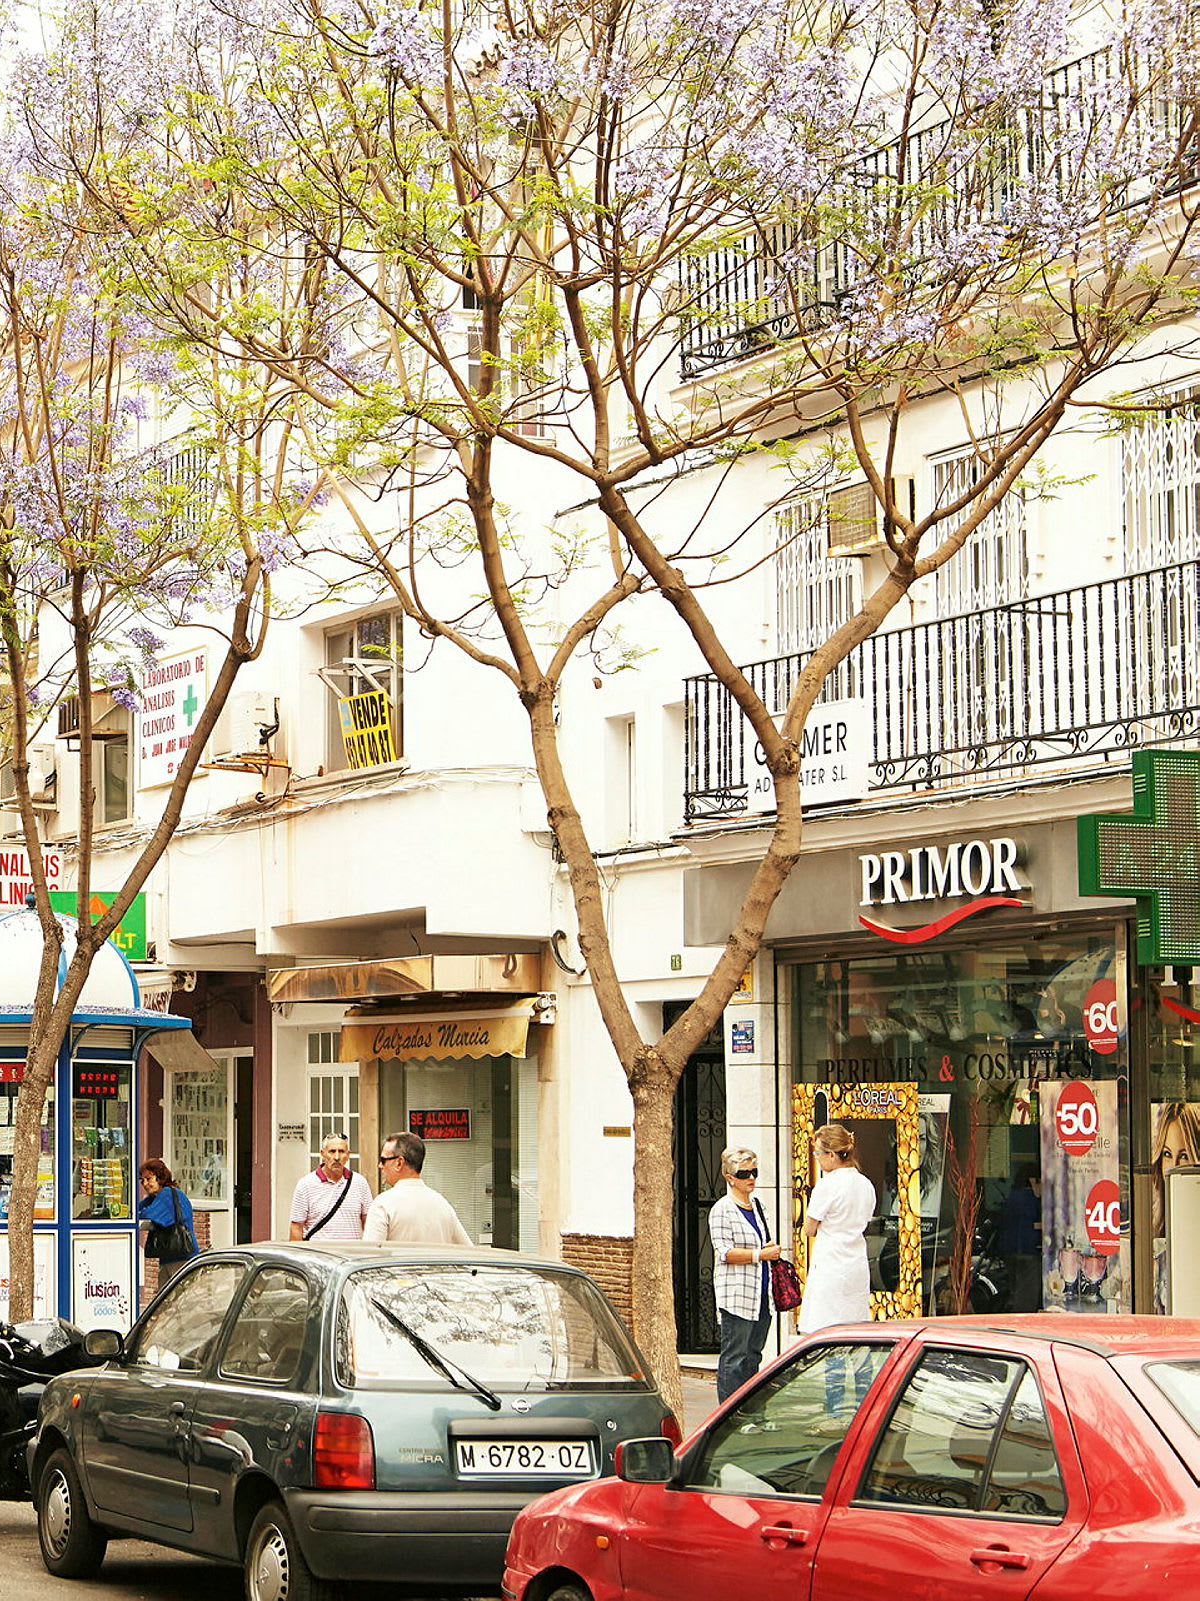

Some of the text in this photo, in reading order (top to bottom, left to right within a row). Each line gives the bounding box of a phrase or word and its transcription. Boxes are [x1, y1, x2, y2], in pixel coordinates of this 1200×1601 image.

[142, 655, 205, 689] LABORATORIO DE
[143, 690, 175, 713] ANALISIS
[349, 693, 387, 731] VENDE
[142, 715, 175, 738] CLINICOS
[858, 837, 1022, 906] PRIMOR
[372, 1022, 491, 1055] Calzados Murcia
[825, 1048, 1092, 1083] PERFUMES & COSMETICS
[410, 1110, 468, 1126] SE ALQUILA
[84, 1280, 120, 1300] ilusión
